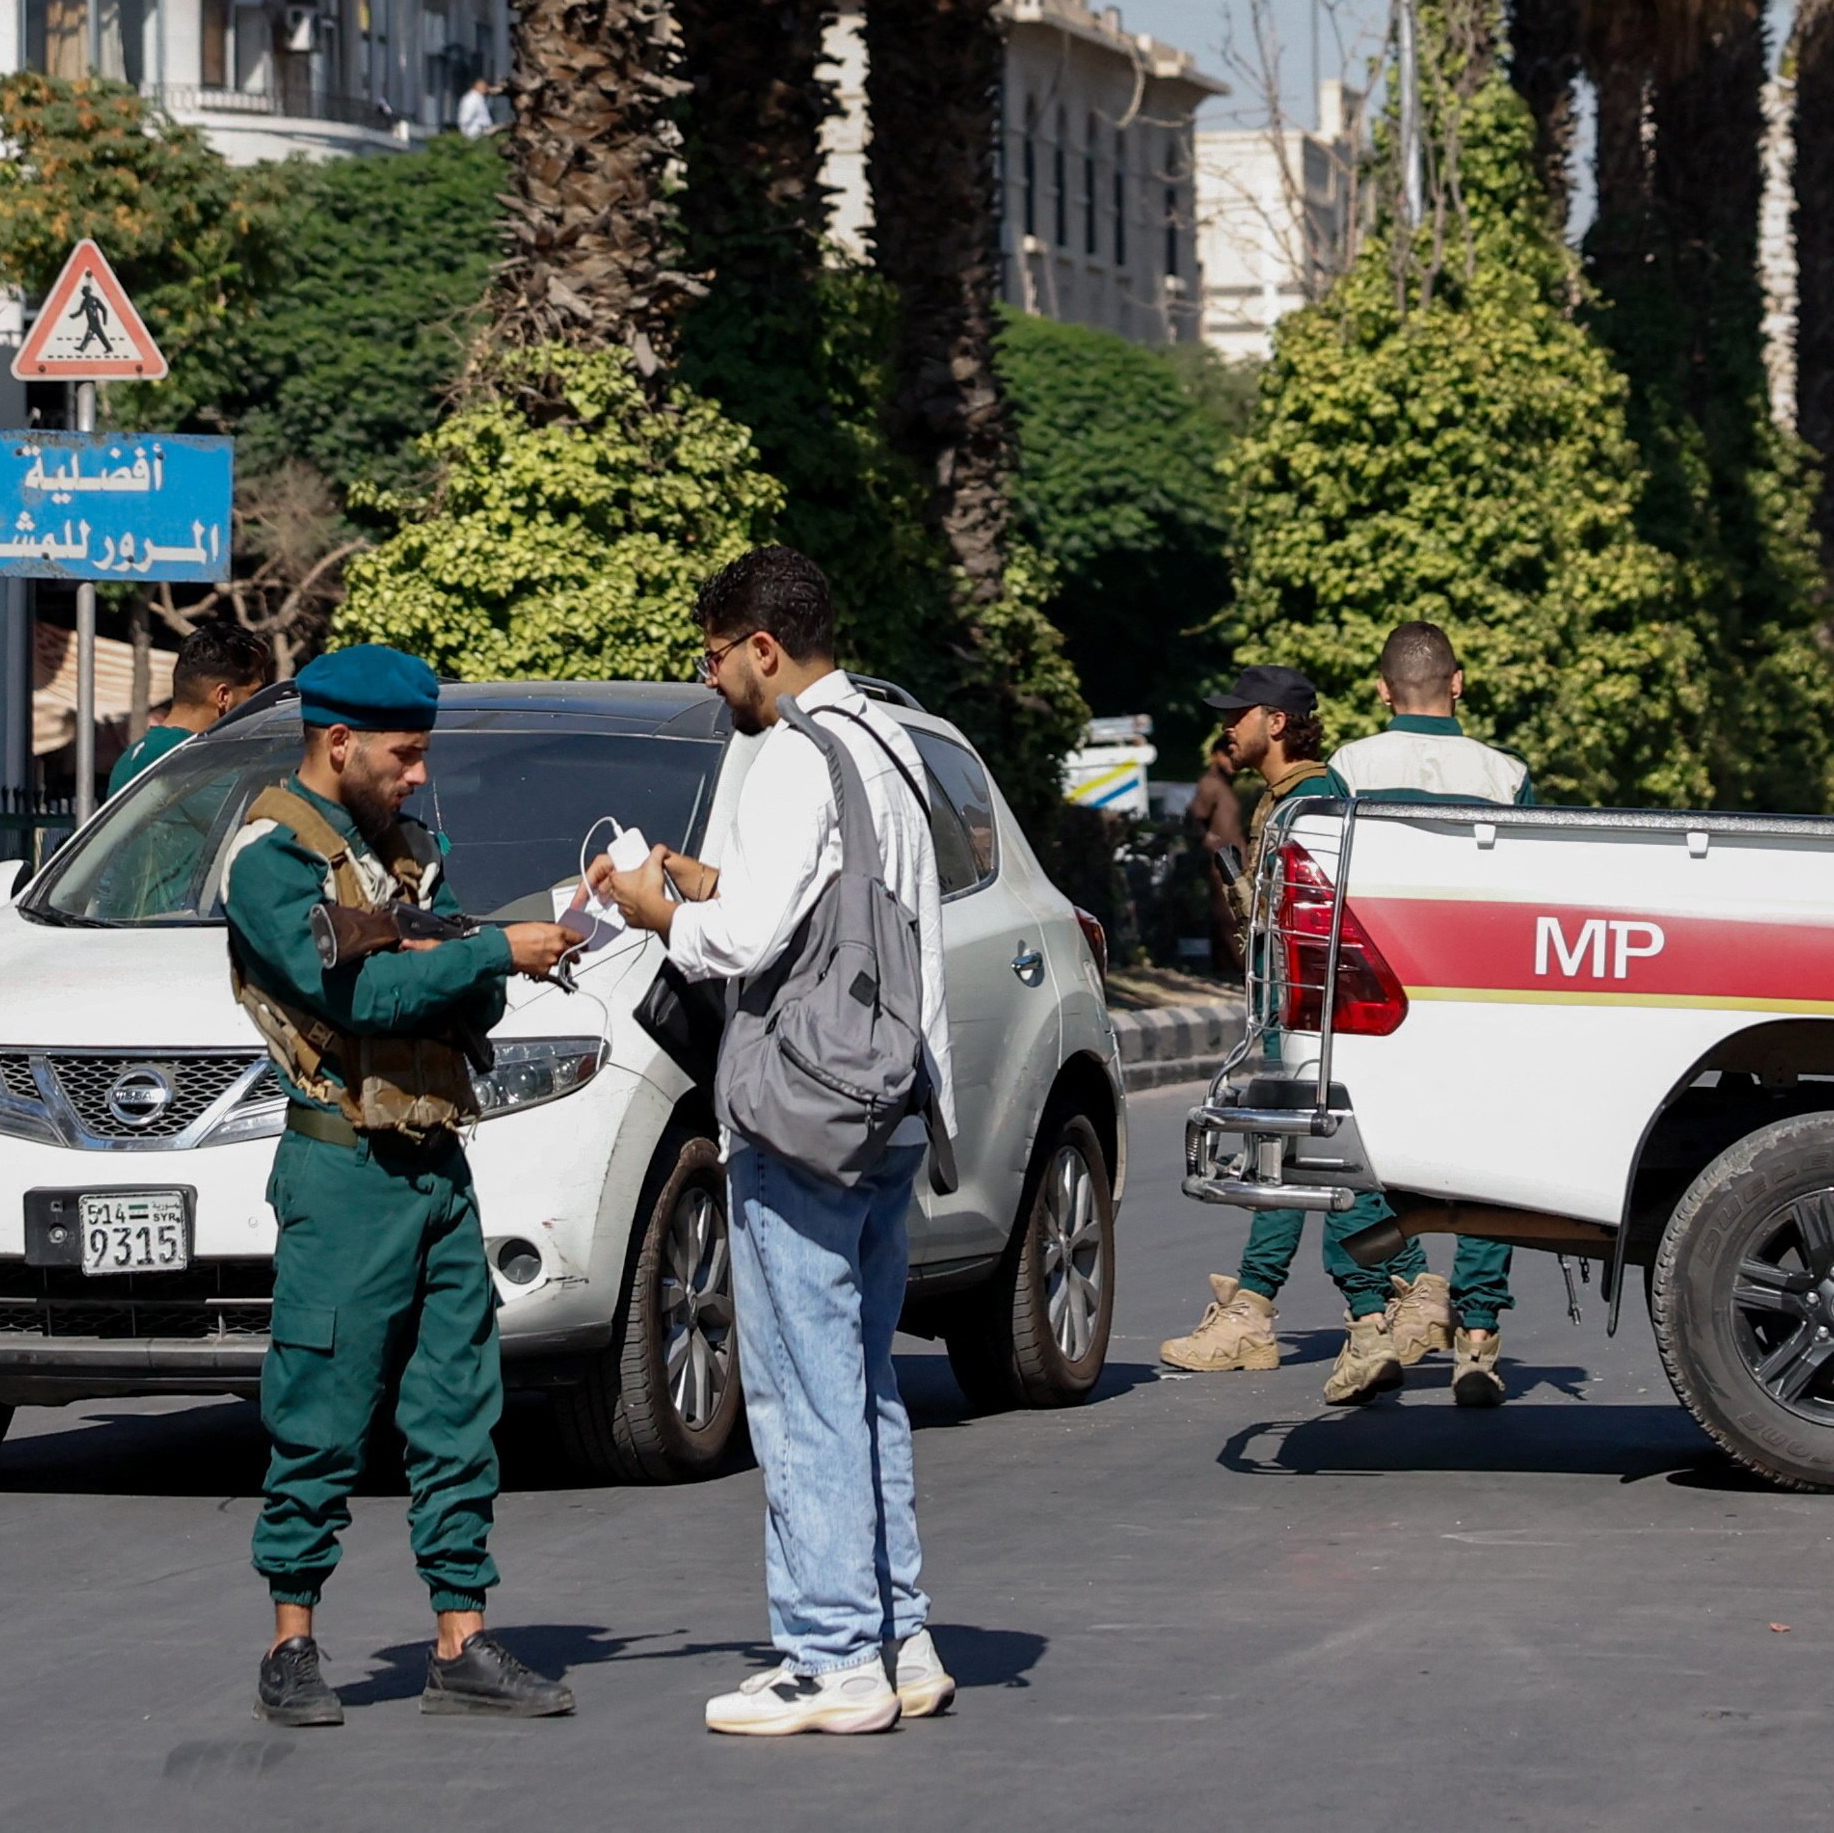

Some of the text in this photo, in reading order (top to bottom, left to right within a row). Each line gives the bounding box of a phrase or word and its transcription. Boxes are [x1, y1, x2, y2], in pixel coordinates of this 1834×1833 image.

[23, 443, 163, 504] أفضلية
[92, 519, 219, 573] المرور
[1535, 916, 1665, 979] MP
[88, 1203, 126, 1225] 514
[153, 1213, 177, 1222] SYR
[90, 1226, 177, 1268] 9315
